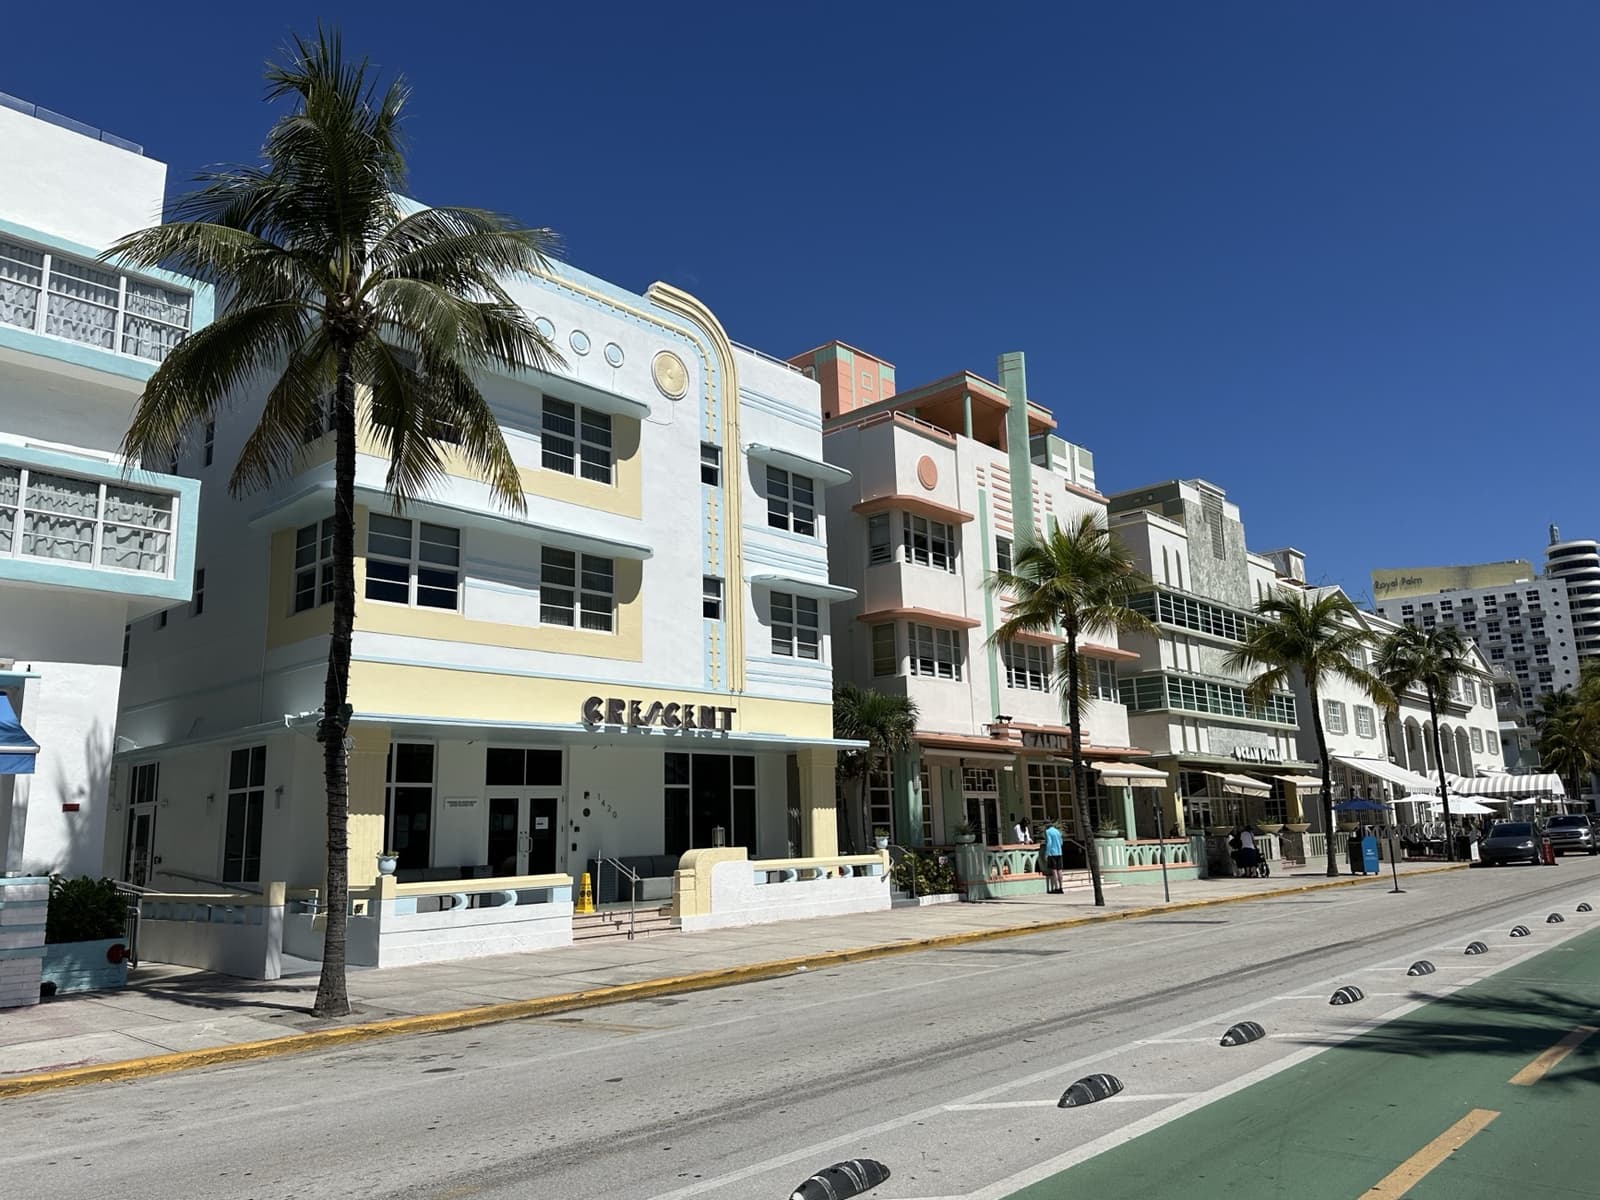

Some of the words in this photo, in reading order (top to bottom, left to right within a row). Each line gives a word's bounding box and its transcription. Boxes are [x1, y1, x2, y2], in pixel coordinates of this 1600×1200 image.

[1374, 576, 1398, 594] Royal
[1400, 576, 1423, 586] Palm
[581, 696, 737, 731] CRESCENT
[1234, 746, 1261, 760] OCEAN
